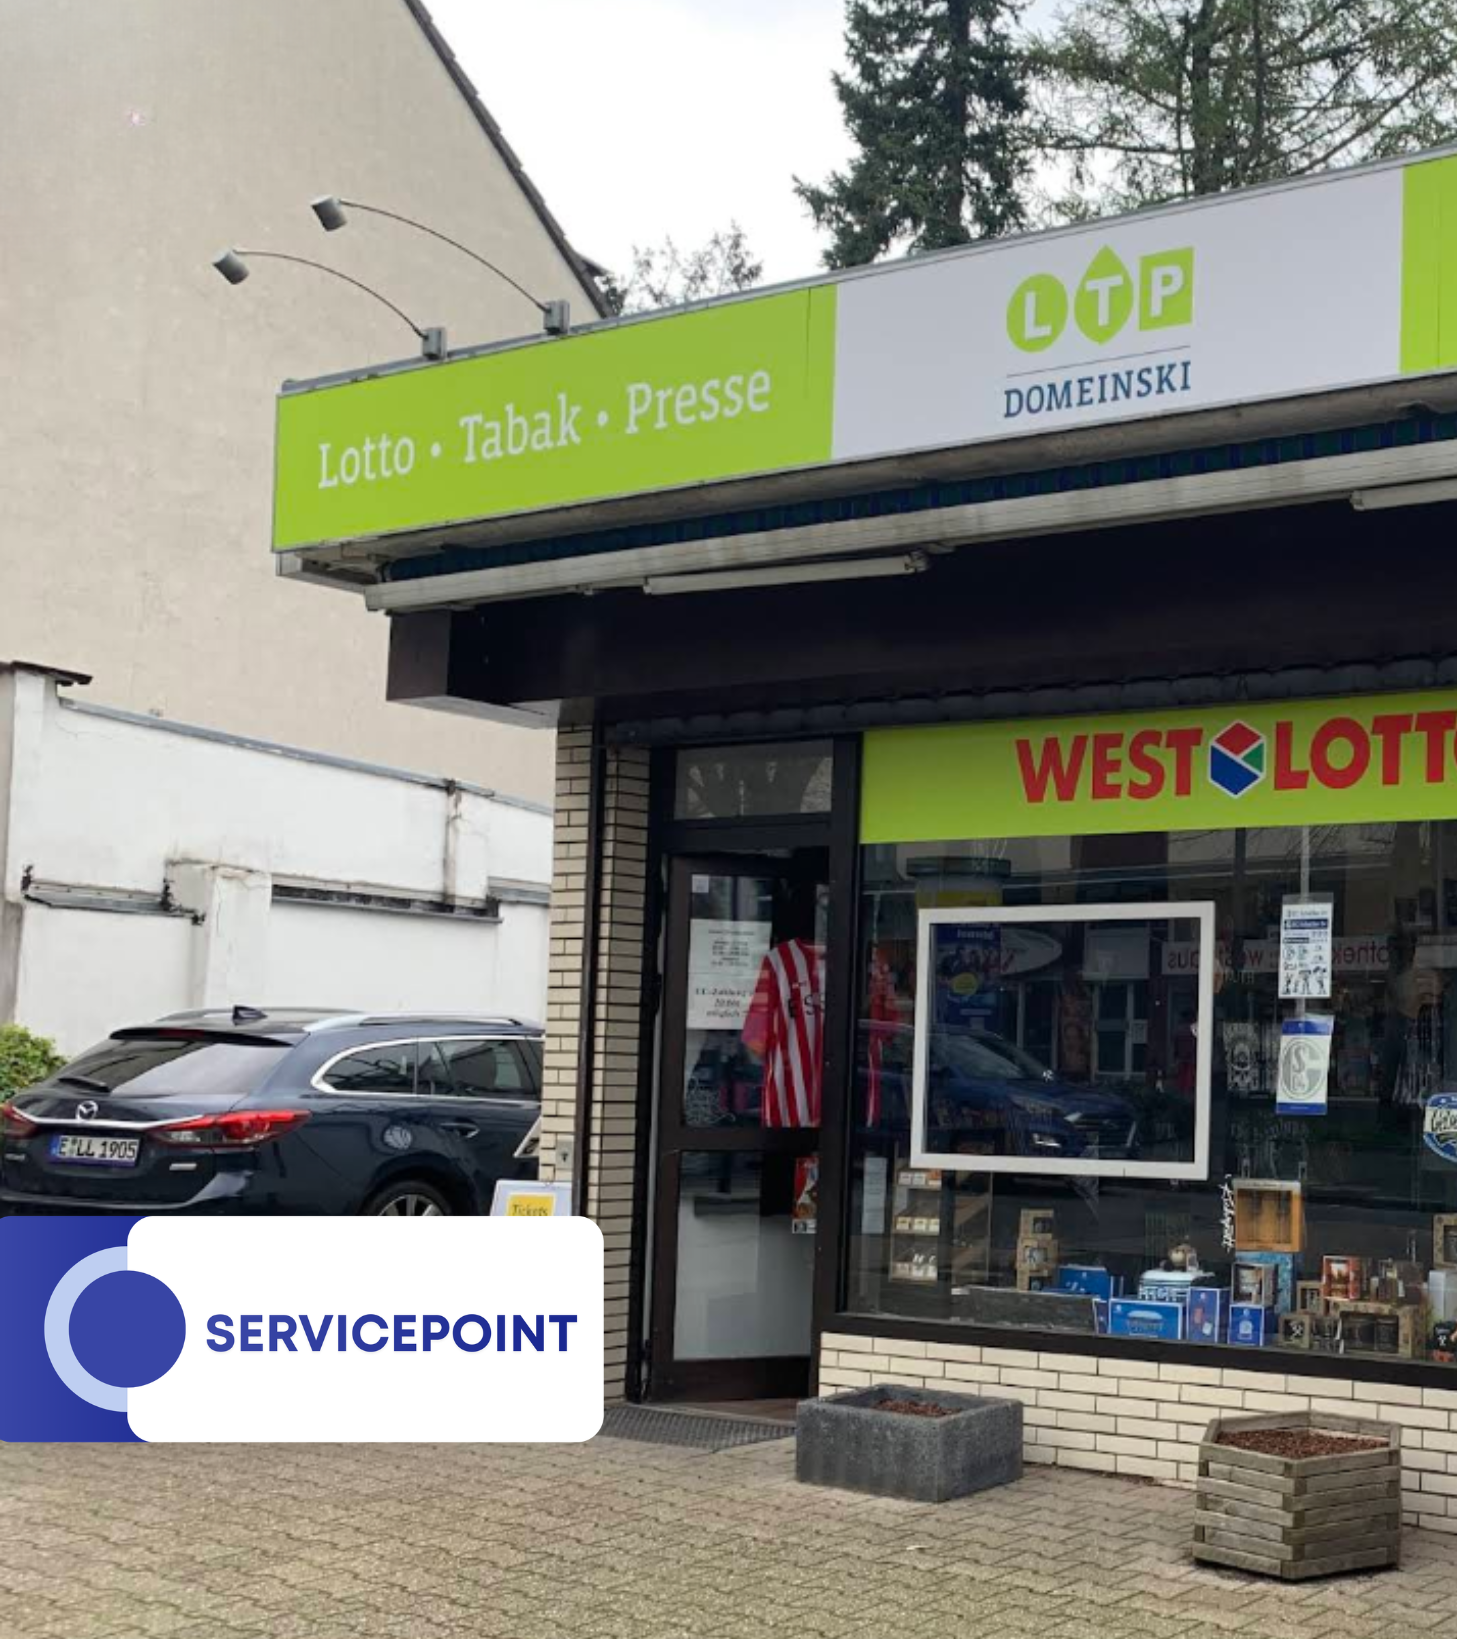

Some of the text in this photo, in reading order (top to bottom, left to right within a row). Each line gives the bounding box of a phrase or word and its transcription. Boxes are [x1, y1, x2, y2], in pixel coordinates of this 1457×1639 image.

[1024, 264, 1184, 342] LTP
[1003, 360, 1191, 419] DOMEINSKI
[318, 369, 771, 490] Lotto Tabak Presse
[1015, 727, 1204, 803] WEST
[59, 1137, 69, 1157] E
[99, 1140, 138, 1159] 1905
